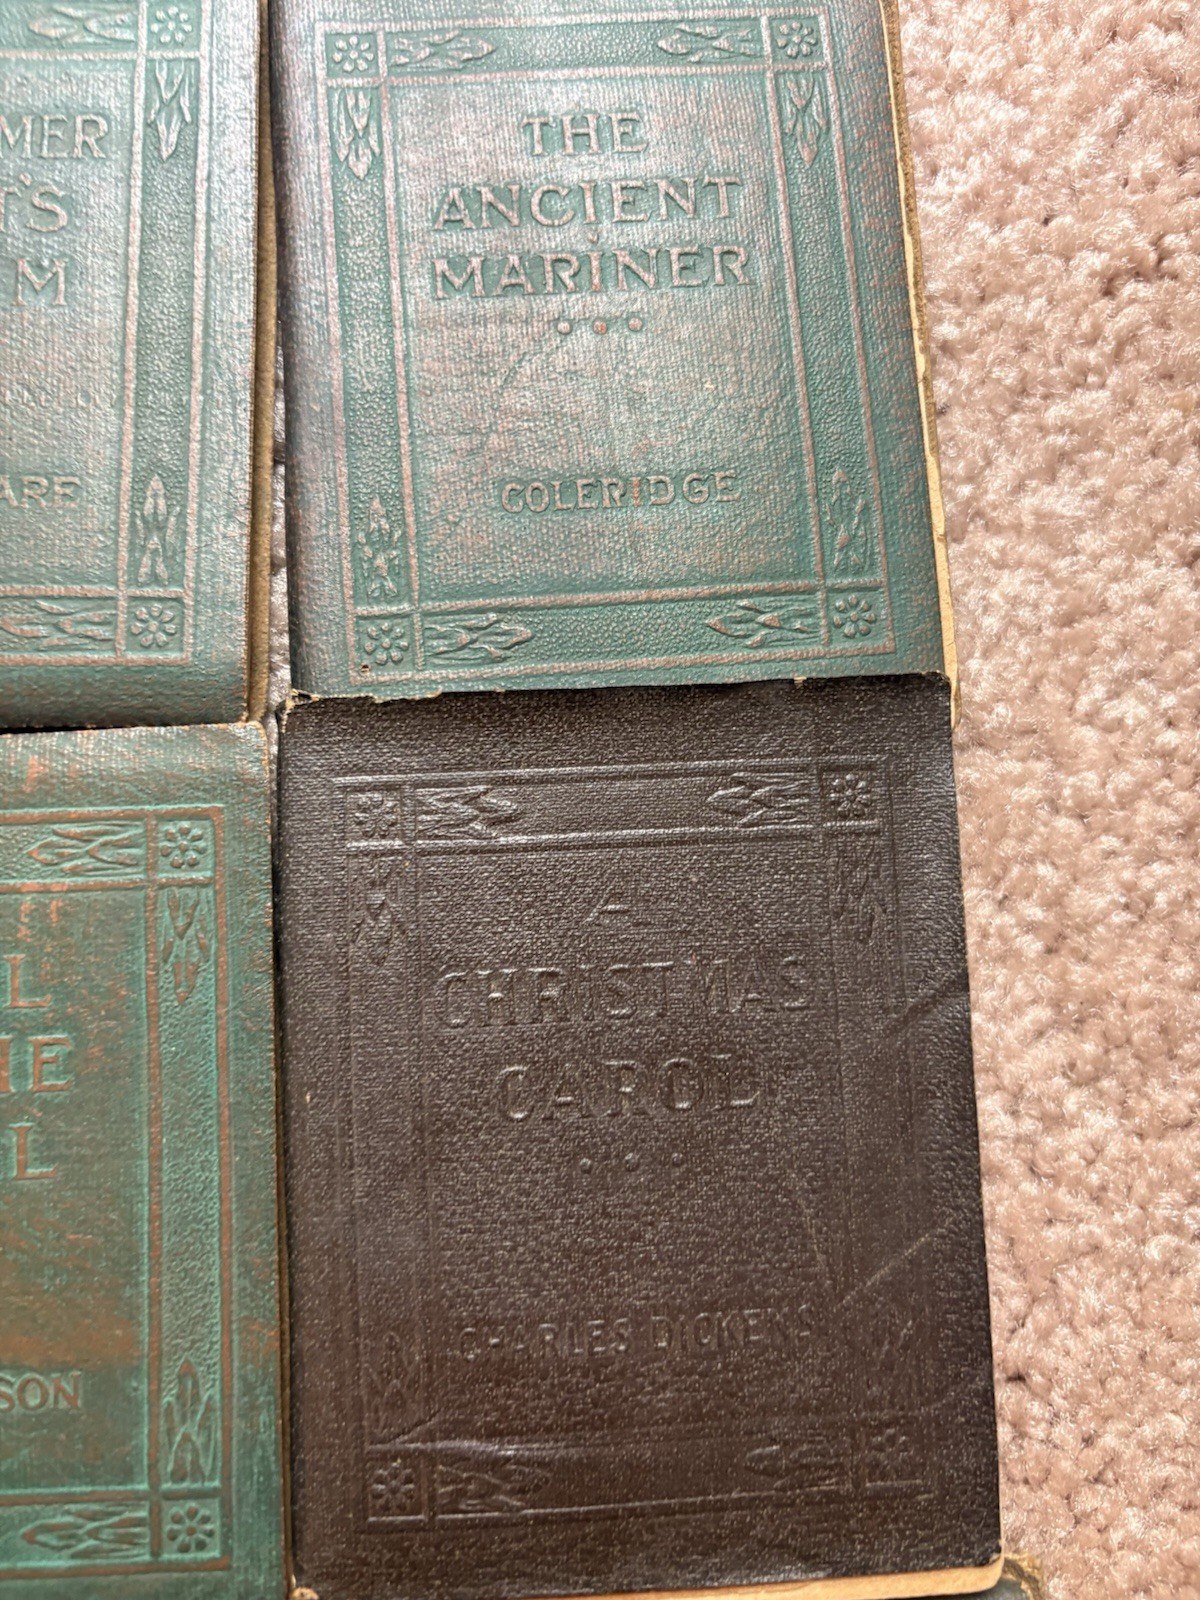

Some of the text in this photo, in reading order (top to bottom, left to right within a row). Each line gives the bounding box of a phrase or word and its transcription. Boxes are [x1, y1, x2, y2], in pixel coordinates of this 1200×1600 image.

[522, 111, 649, 157] THE
[433, 175, 742, 231] ANCIENT
[432, 245, 752, 300] MARINER
[500, 470, 742, 514] COLERIDGE
[438, 954, 810, 1029] CHRISTMAS
[499, 1052, 762, 1122] CAROL
[458, 1302, 814, 1364] CHARLES DICKENS
